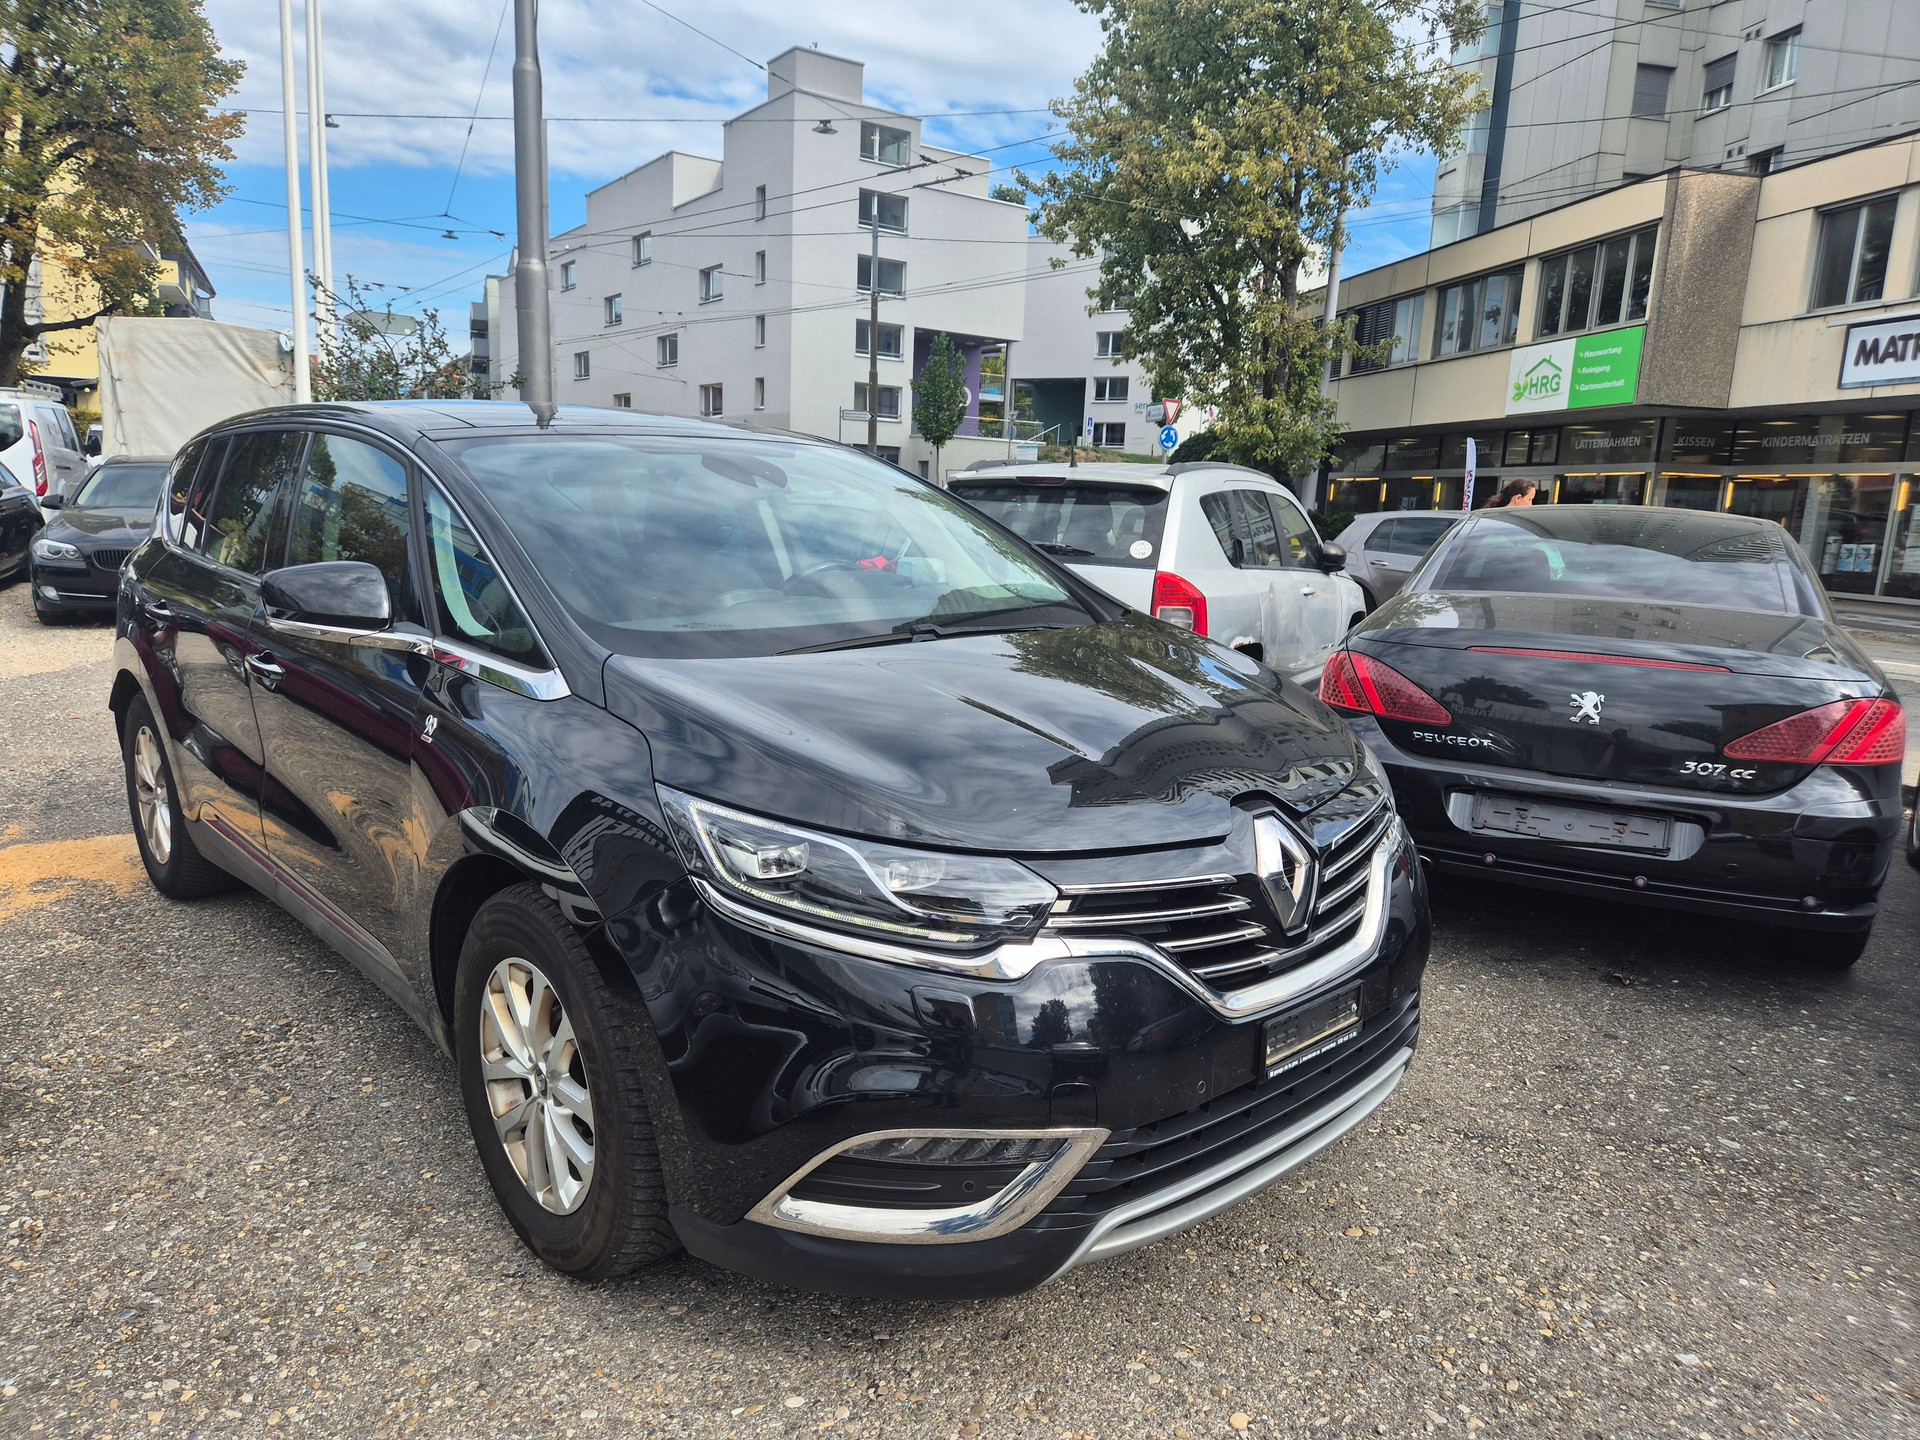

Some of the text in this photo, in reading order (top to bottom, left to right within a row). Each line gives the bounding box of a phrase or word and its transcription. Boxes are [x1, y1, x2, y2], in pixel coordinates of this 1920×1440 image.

[1581, 364, 1611, 375] Reinigung
[1528, 373, 1562, 395] HRG
[1579, 379, 1625, 392] Gartenunterhalt
[1574, 436, 1641, 450] LATTENRAHMEN
[1677, 435, 1715, 448] KISSEN
[1761, 432, 1871, 448] KINDERMATRATZEN
[1412, 730, 1492, 749] PEUGEOT
[1679, 761, 1727, 777] 307
